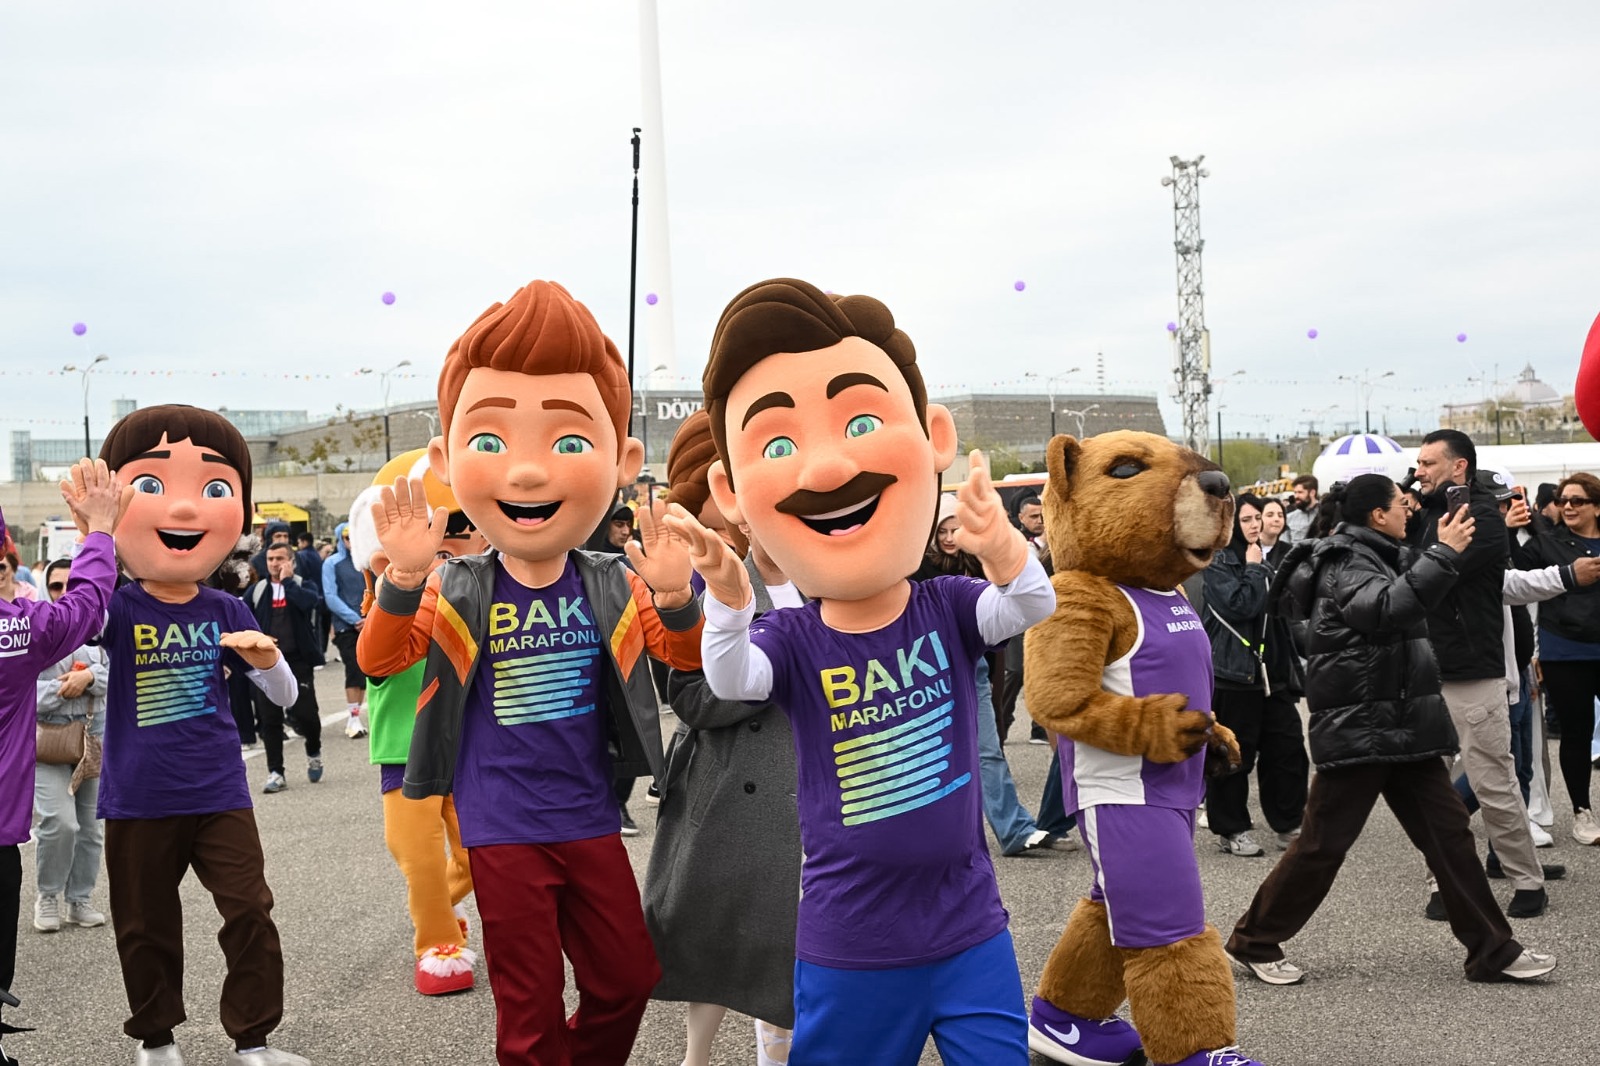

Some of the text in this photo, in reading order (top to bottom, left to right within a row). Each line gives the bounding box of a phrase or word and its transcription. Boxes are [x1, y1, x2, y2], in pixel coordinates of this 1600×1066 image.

[0, 615, 31, 632] BAKI
[489, 596, 595, 636] BAK
[134, 621, 220, 651] BAKI
[490, 629, 600, 654] MARAFONU
[135, 649, 220, 666] MARAFONU
[820, 630, 950, 709] BAKI
[830, 675, 952, 732] MARAFONU
